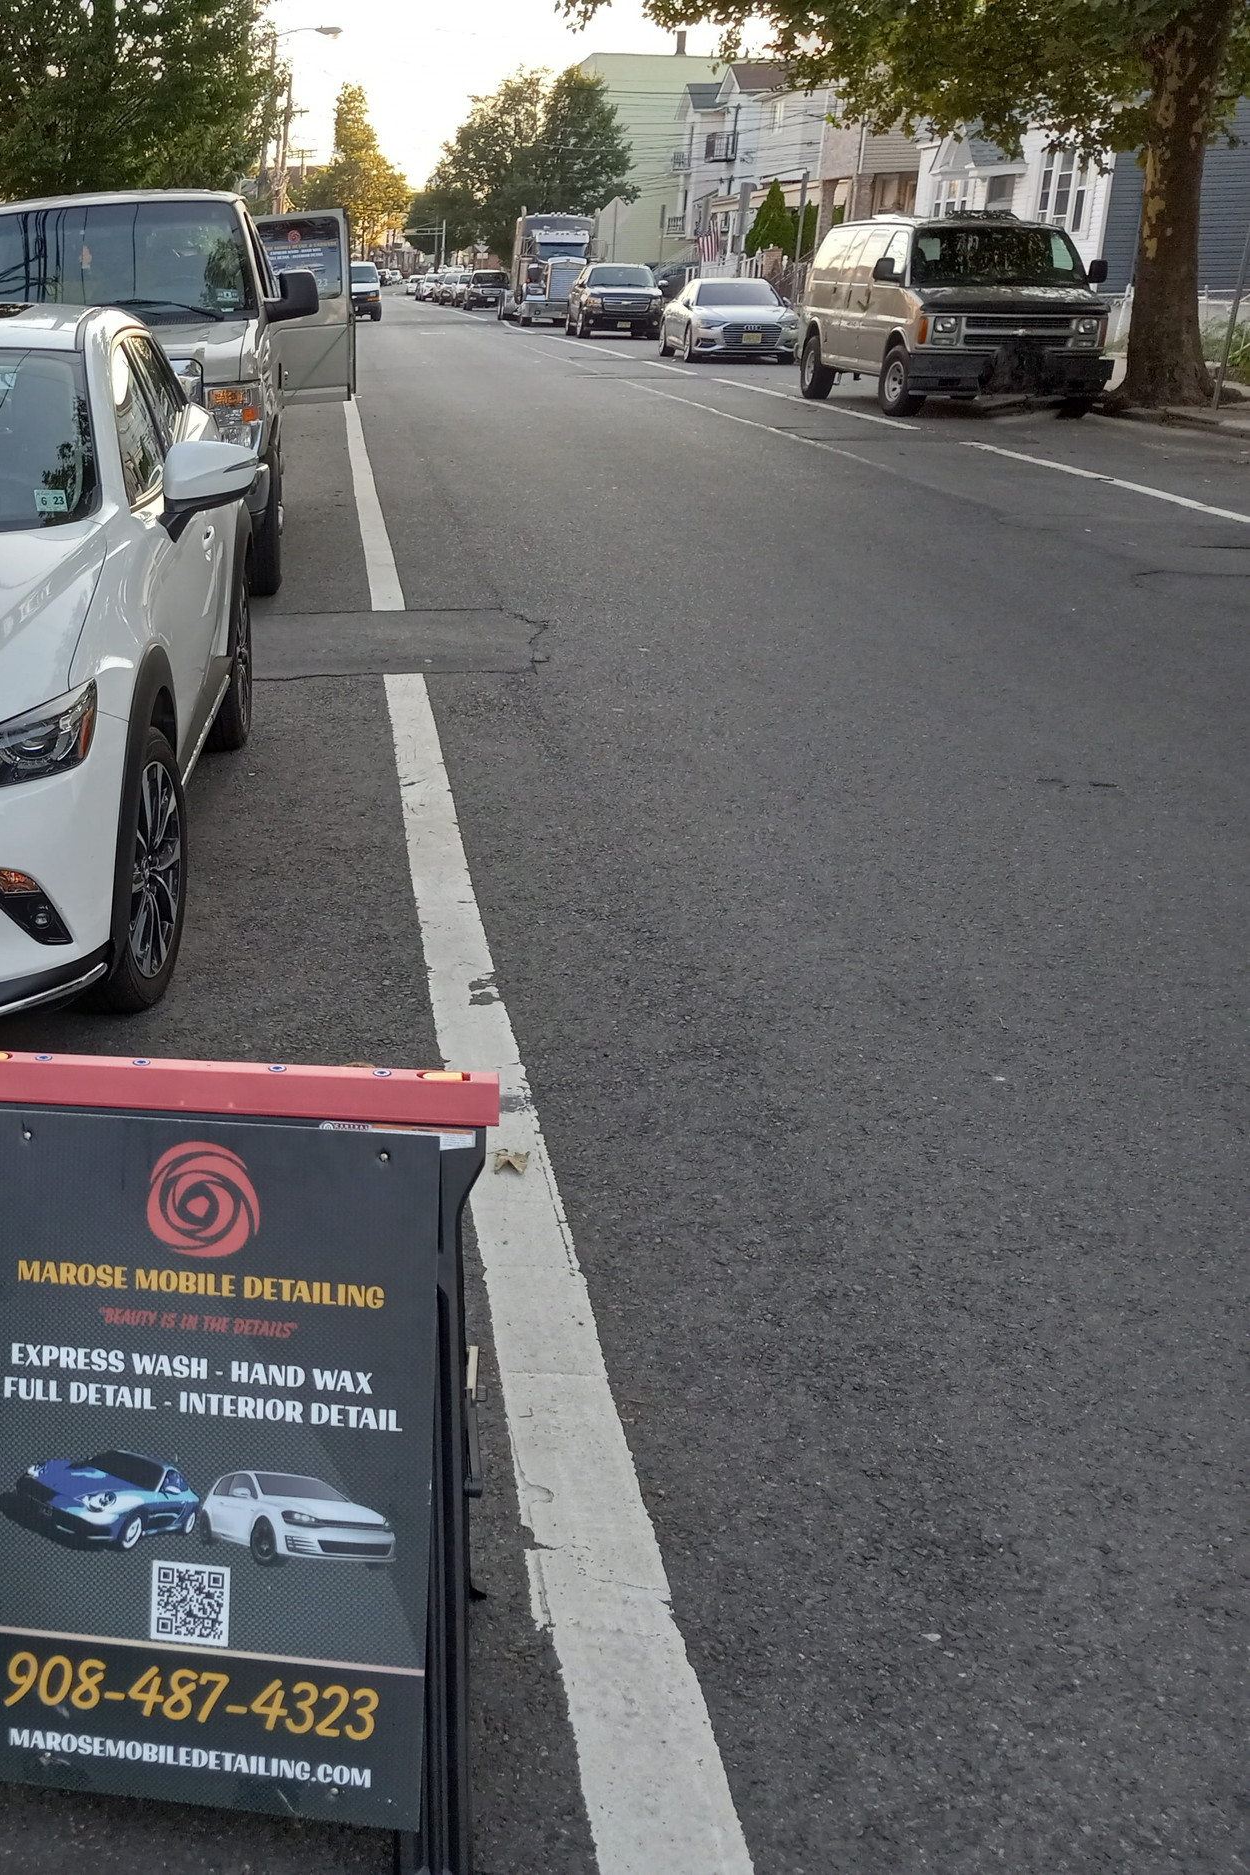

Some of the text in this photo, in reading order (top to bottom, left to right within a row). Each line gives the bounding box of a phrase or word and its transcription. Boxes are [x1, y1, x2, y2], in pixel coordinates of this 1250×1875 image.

[41, 496, 65, 506] 6 23
[17, 1259, 385, 1309] MAROSE MOBILE DETAILING
[161, 1312, 177, 1329] IS
[180, 1314, 199, 1330] IN
[203, 1315, 229, 1333] THE
[11, 1342, 125, 1373] EXPRESS
[131, 1352, 208, 1380] WASH
[231, 1360, 306, 1388] HAND
[312, 1368, 373, 1394] WAX
[4, 1376, 62, 1402] FULL
[69, 1381, 157, 1410] DETAIL
[179, 1391, 303, 1424] INTERIOR
[310, 1402, 403, 1432] DETAIL
[4, 1651, 380, 1741] 908-487-4323
[8, 1727, 372, 1788] MAROSEMOBILEDETAILING.COM
